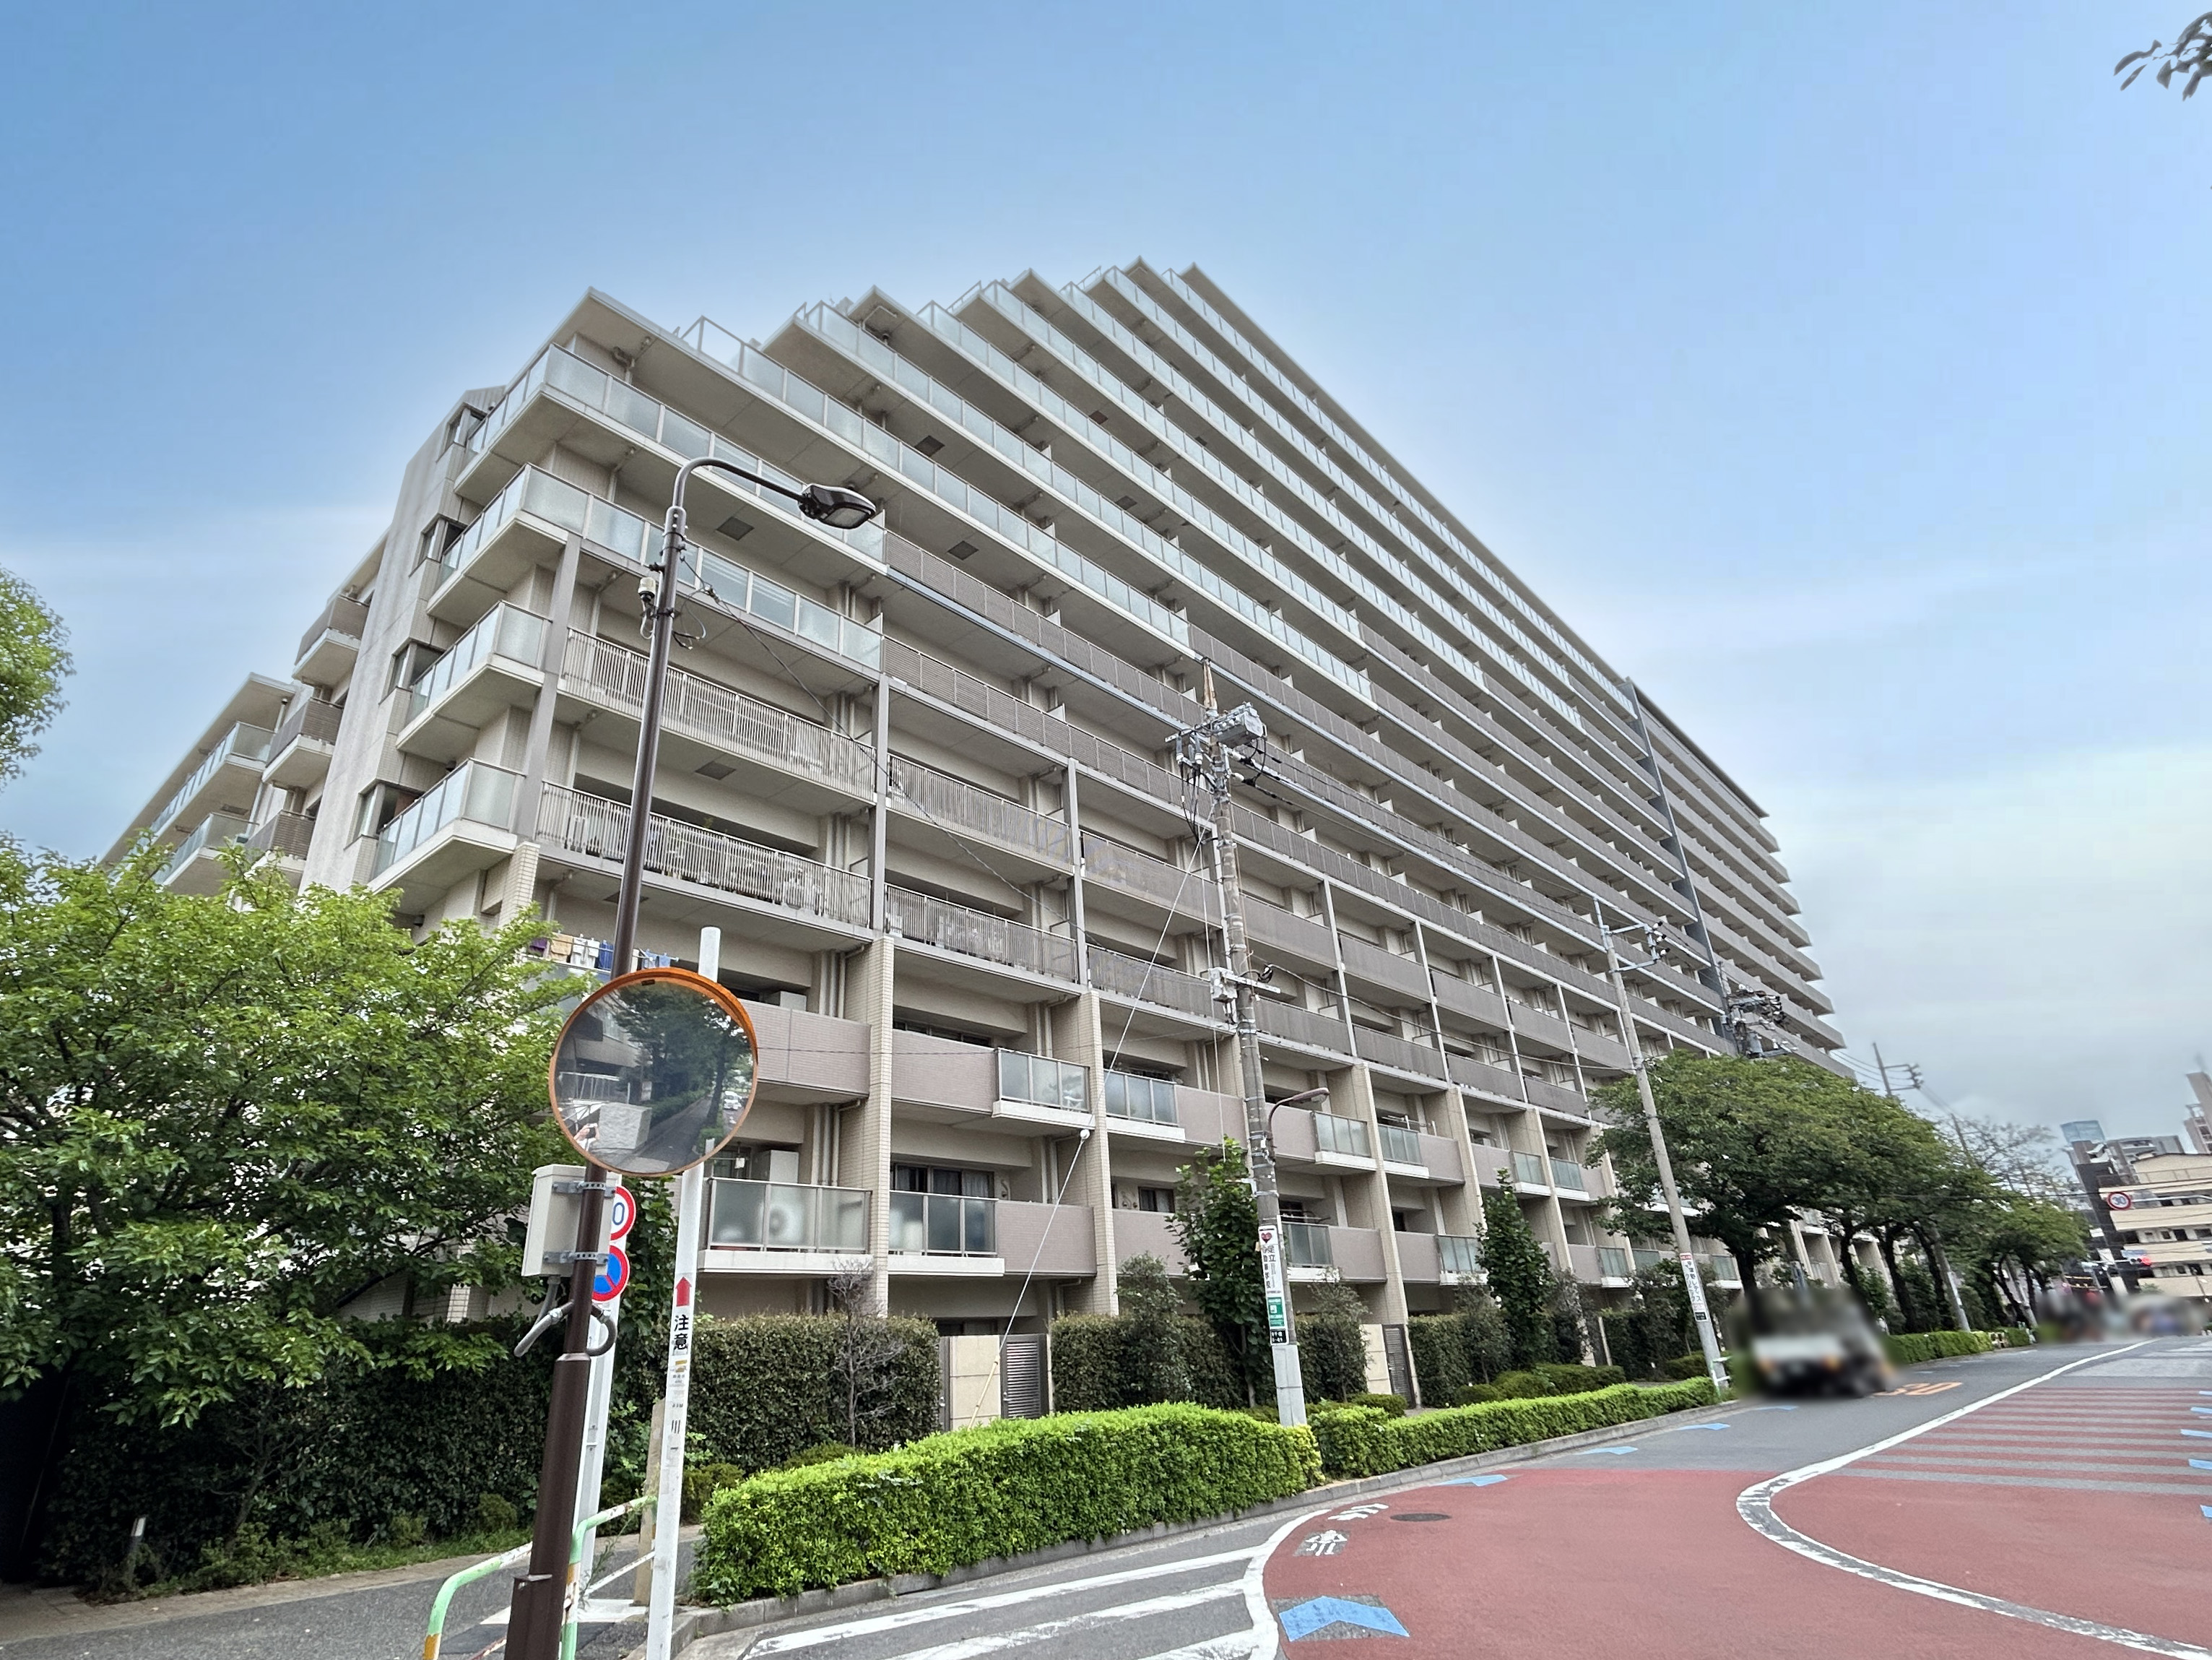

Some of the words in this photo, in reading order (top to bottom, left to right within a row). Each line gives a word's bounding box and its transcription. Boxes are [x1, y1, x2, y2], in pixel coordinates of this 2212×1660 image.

[612, 1201, 625, 1226] 0
[2112, 1196, 2127, 1206] 30
[674, 1314, 690, 1350] 注意
